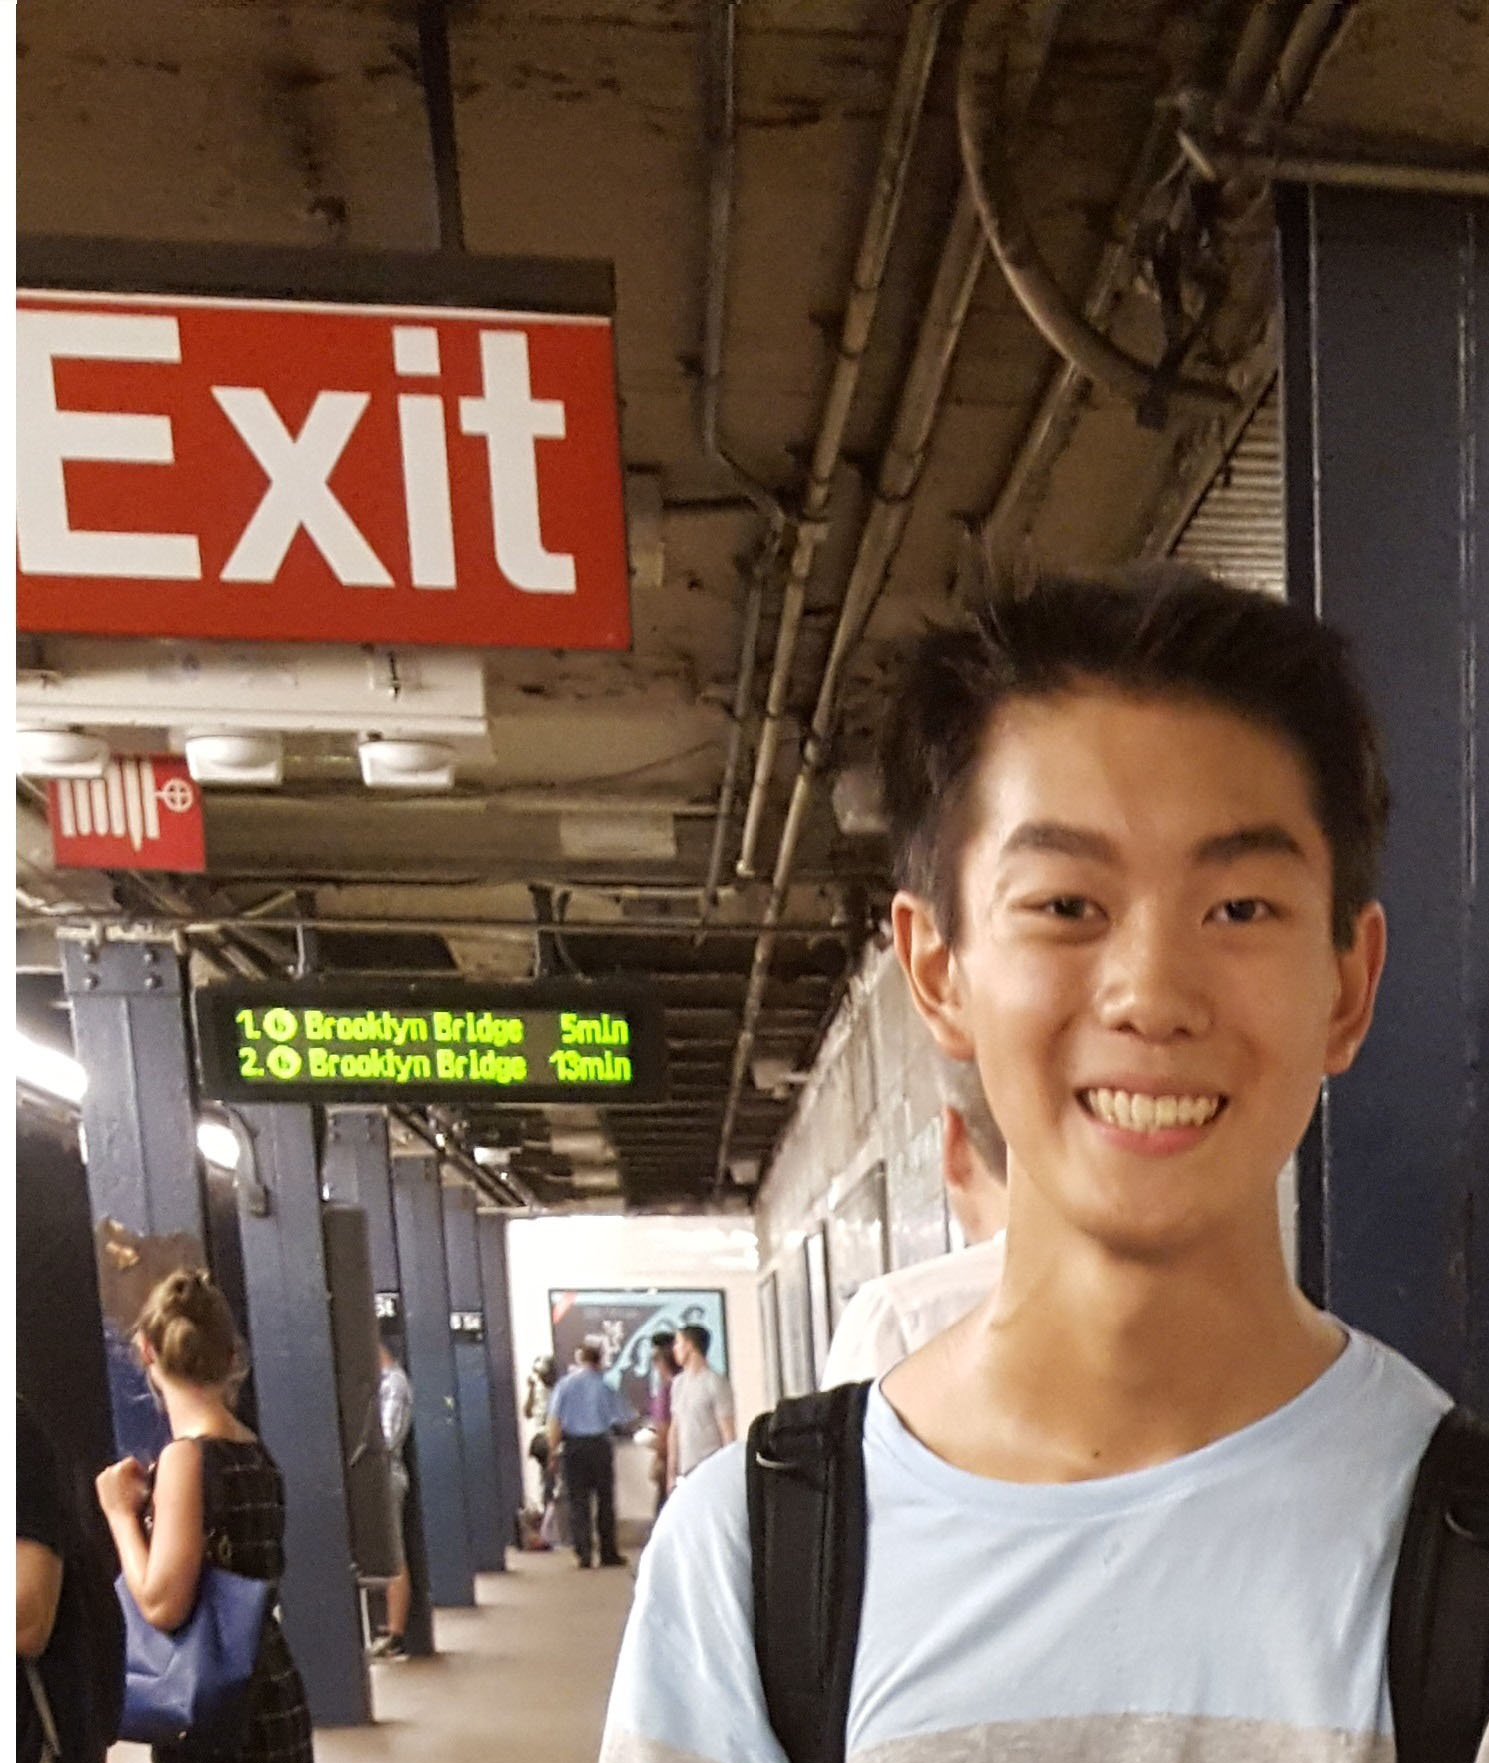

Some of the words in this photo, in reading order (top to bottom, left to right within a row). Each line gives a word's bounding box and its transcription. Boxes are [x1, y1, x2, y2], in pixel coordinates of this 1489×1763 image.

[16, 308, 577, 594] Exit
[304, 1010, 428, 1046] Brooklyn
[433, 1011, 524, 1047] Bridge
[560, 1012, 629, 1045] 5min
[308, 1047, 431, 1083] Brooklyn
[436, 1048, 528, 1084] Bridge
